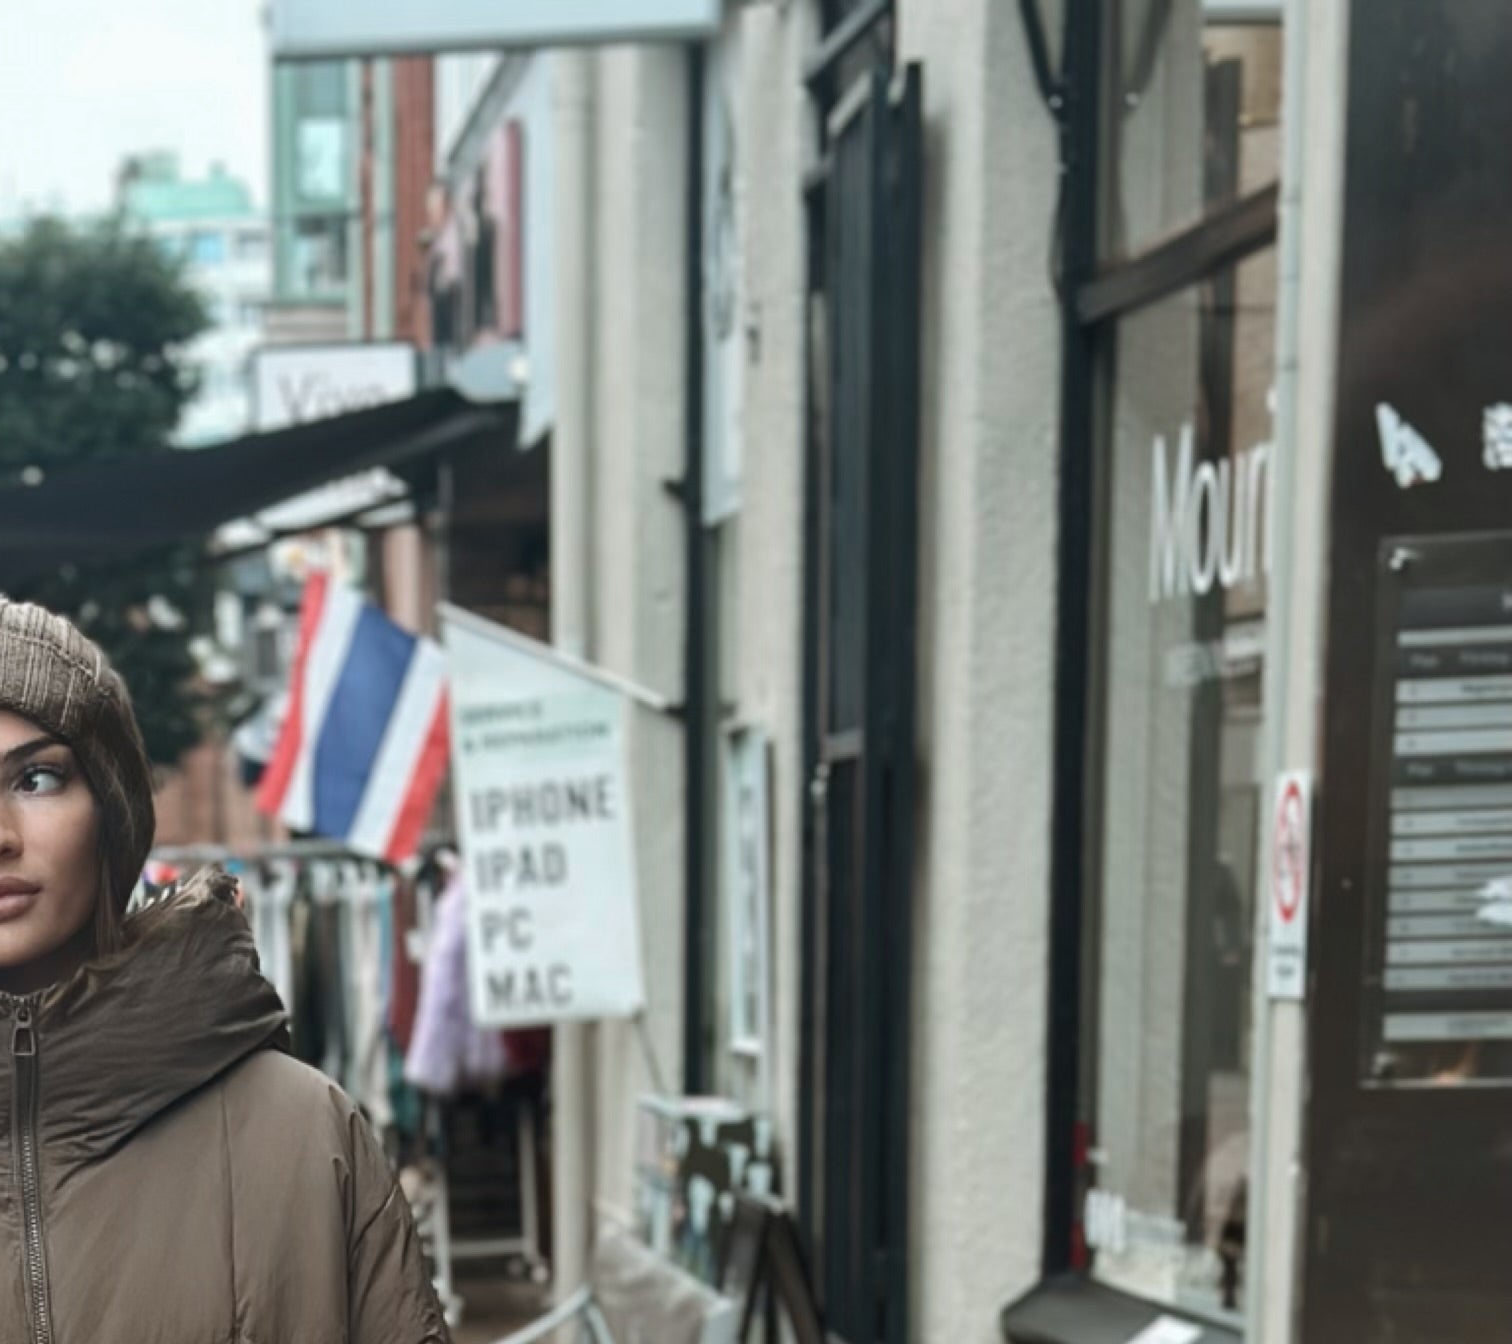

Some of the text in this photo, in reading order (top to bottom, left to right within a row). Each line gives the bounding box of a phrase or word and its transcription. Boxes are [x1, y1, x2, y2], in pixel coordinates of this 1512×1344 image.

[469, 774, 617, 834] IPHONE
[473, 842, 568, 894] IPAD
[480, 907, 533, 951] PC
[487, 962, 573, 1008] MAC
